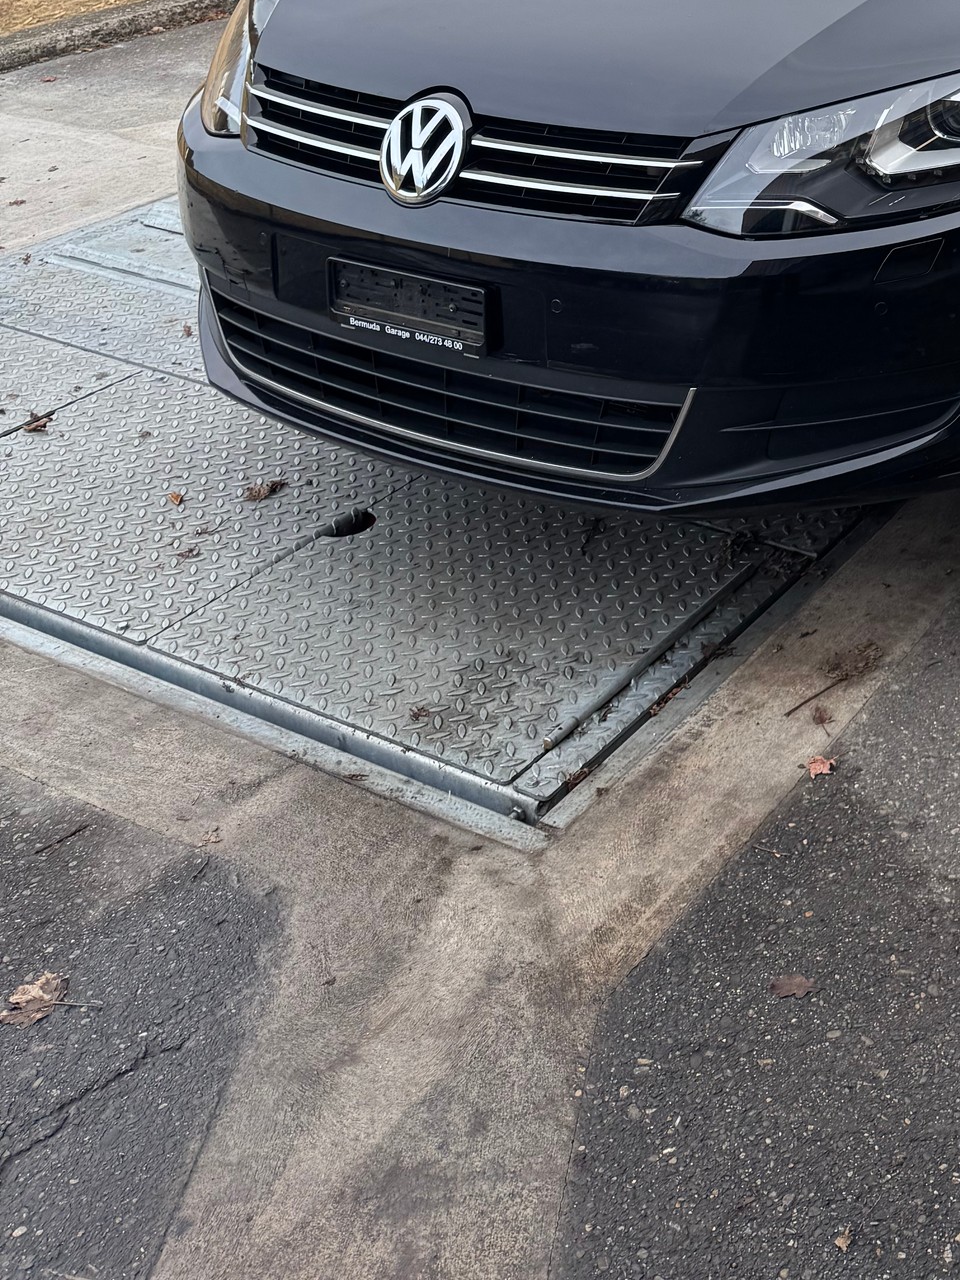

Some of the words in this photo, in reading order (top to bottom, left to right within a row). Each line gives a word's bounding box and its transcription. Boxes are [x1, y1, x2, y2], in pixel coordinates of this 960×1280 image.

[384, 102, 460, 199] VW
[349, 317, 381, 332] Bermuda
[385, 325, 411, 339] Garage
[415, 332, 443, 346] 044/273
[443, 339, 453, 348] 48
[453, 341, 463, 351] 00
